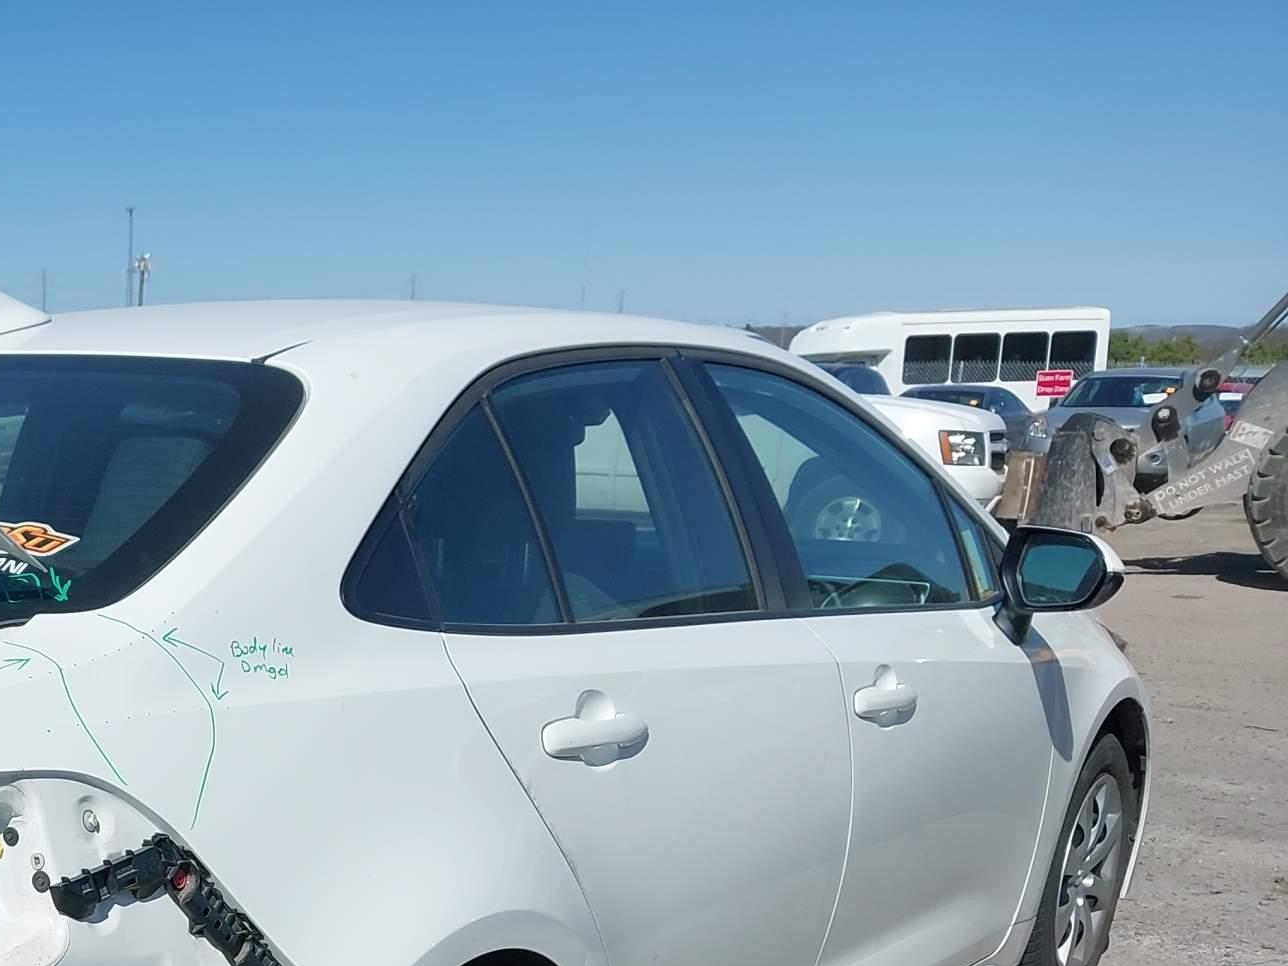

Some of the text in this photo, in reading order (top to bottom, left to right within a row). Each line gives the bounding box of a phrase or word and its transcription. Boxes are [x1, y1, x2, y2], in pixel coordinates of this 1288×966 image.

[1155, 451, 1251, 501] DO NOT WALK
[1168, 464, 1250, 509] UNDER MAST
[230, 635, 268, 660] Body
